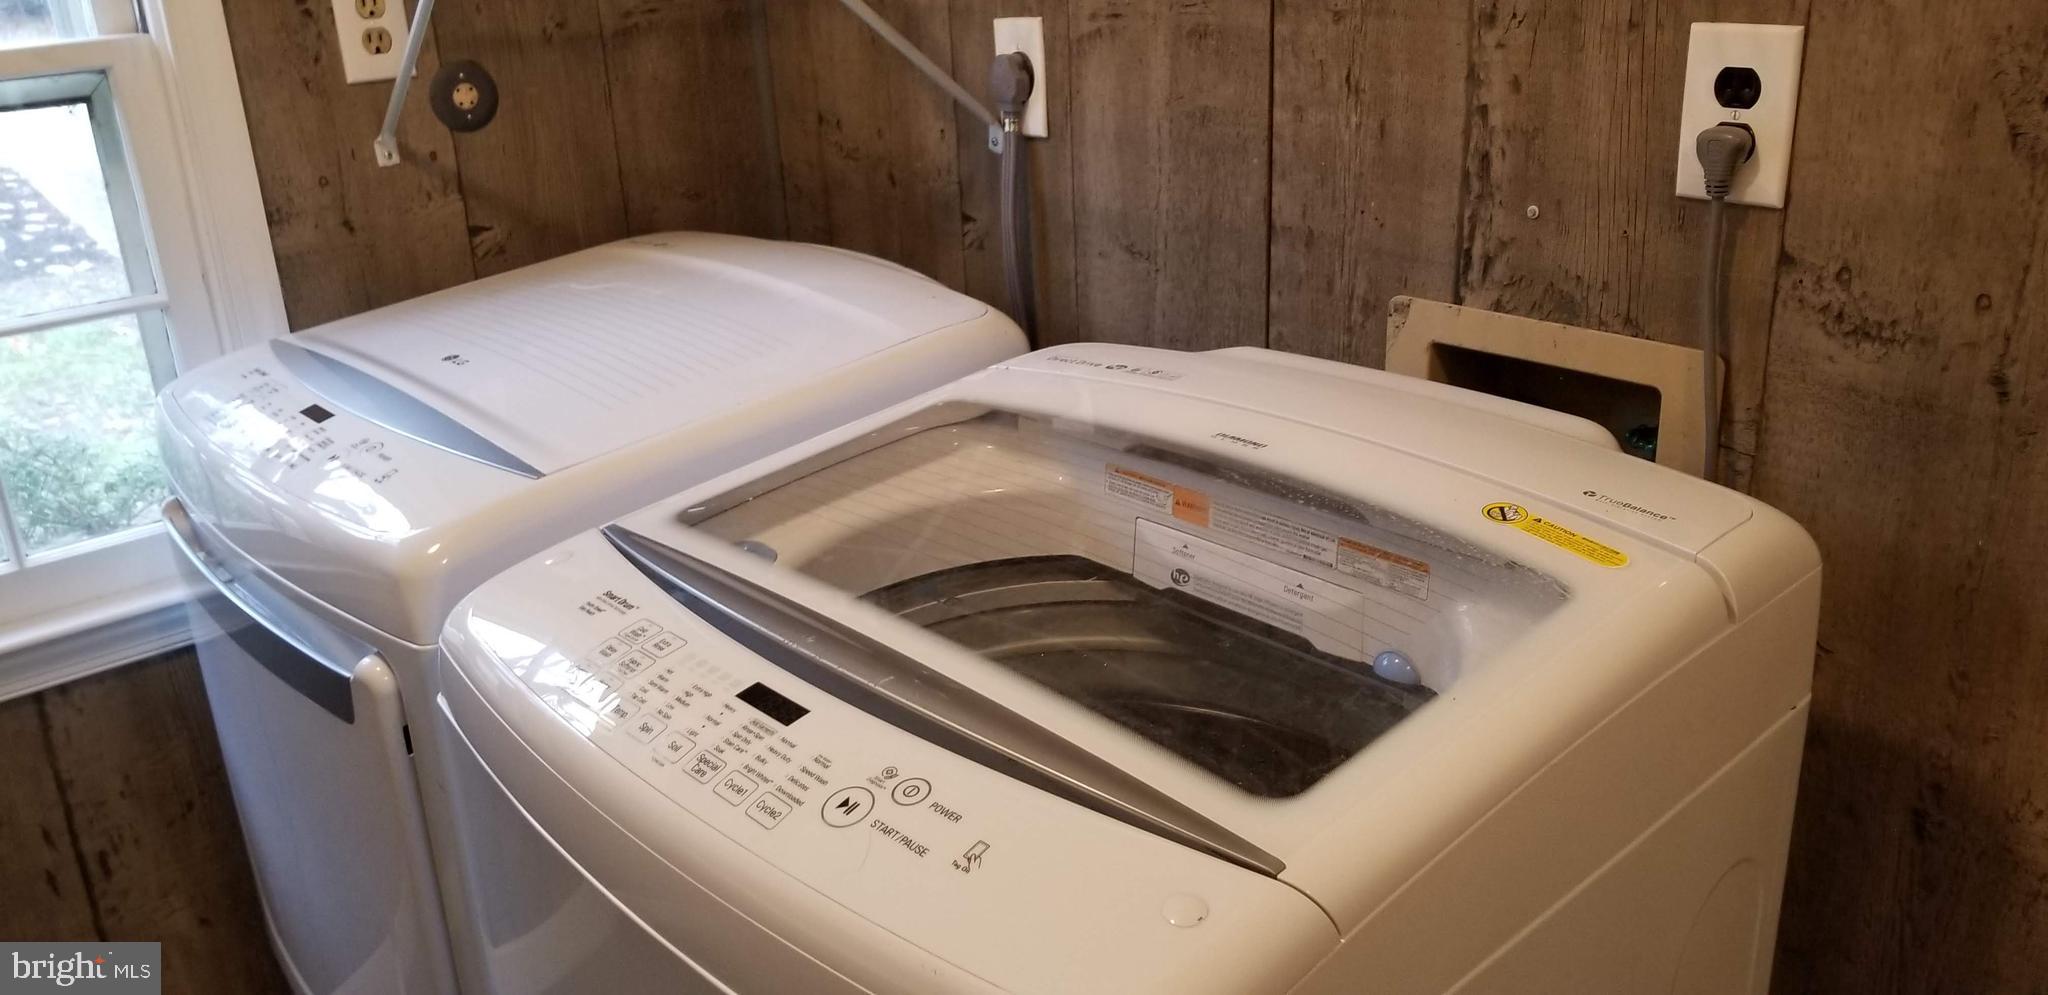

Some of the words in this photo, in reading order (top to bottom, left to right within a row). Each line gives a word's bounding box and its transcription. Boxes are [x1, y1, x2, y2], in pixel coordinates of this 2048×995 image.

[1543, 521, 1577, 537] CAUTION
[1171, 545, 1196, 560] Softener
[1283, 585, 1314, 601] Detergent
[639, 722, 654, 735] Spin
[667, 740, 683, 752] Soil
[690, 763, 708, 778] Care
[696, 753, 722, 772] Special
[724, 778, 748, 797] Cycle1
[787, 775, 809, 791] Delicates
[775, 785, 805, 807] Downloaded
[755, 799, 782, 821] Cycle2
[929, 801, 963, 824] POWER
[870, 818, 931, 858] START/PAUSE
